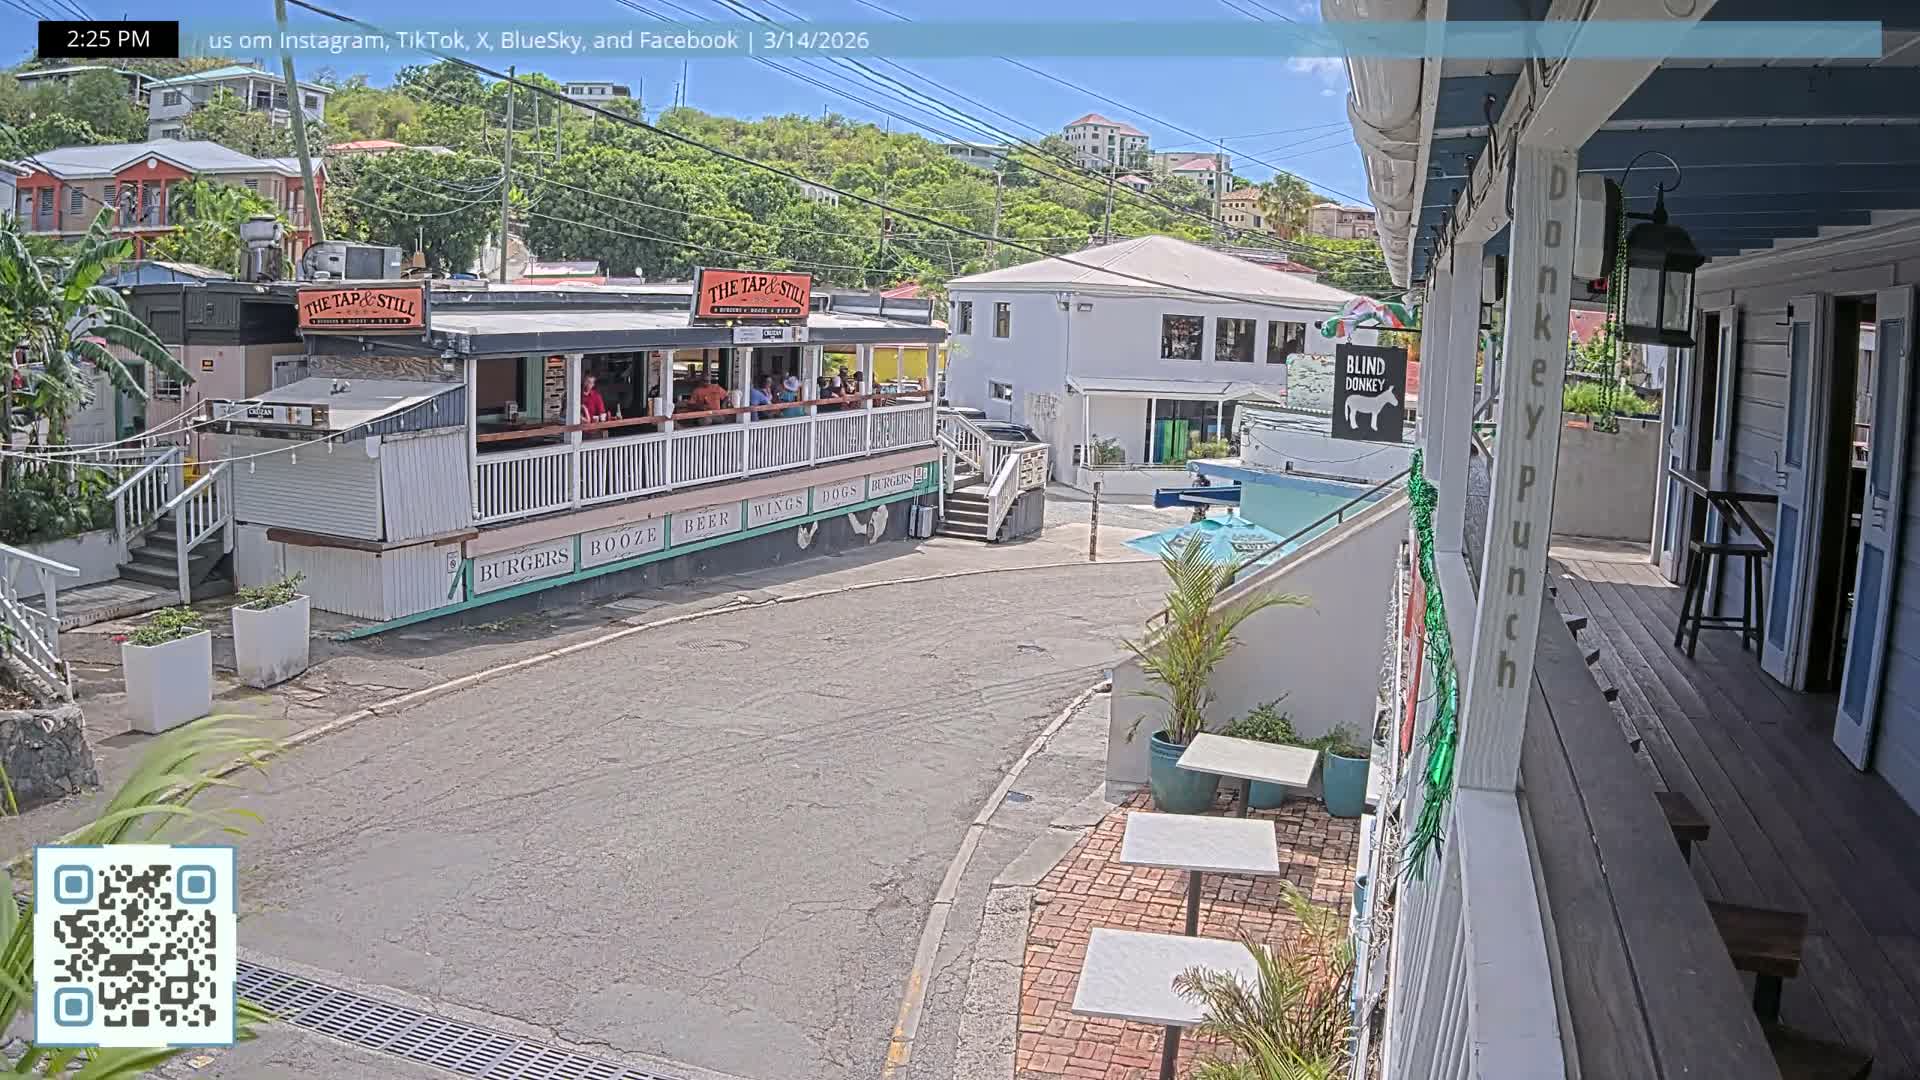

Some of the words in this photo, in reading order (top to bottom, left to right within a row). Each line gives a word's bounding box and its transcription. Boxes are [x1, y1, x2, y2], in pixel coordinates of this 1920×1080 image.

[707, 279, 739, 304] THE
[740, 276, 767, 294] TAP
[765, 275, 780, 295] &
[779, 280, 805, 307] STILL
[304, 296, 332, 317] THE
[331, 292, 360, 308] TAP
[359, 290, 377, 307] &
[377, 293, 416, 317] STILL
[1346, 355, 1386, 376] BLIND
[1345, 377, 1386, 392] DONKEY
[870, 472, 912, 492] BURGERS
[823, 485, 857, 504] DOGS
[753, 496, 804, 518] WINGS
[684, 511, 729, 534] BEER
[591, 527, 657, 557] BOOZE
[479, 548, 570, 583] BURGERS
